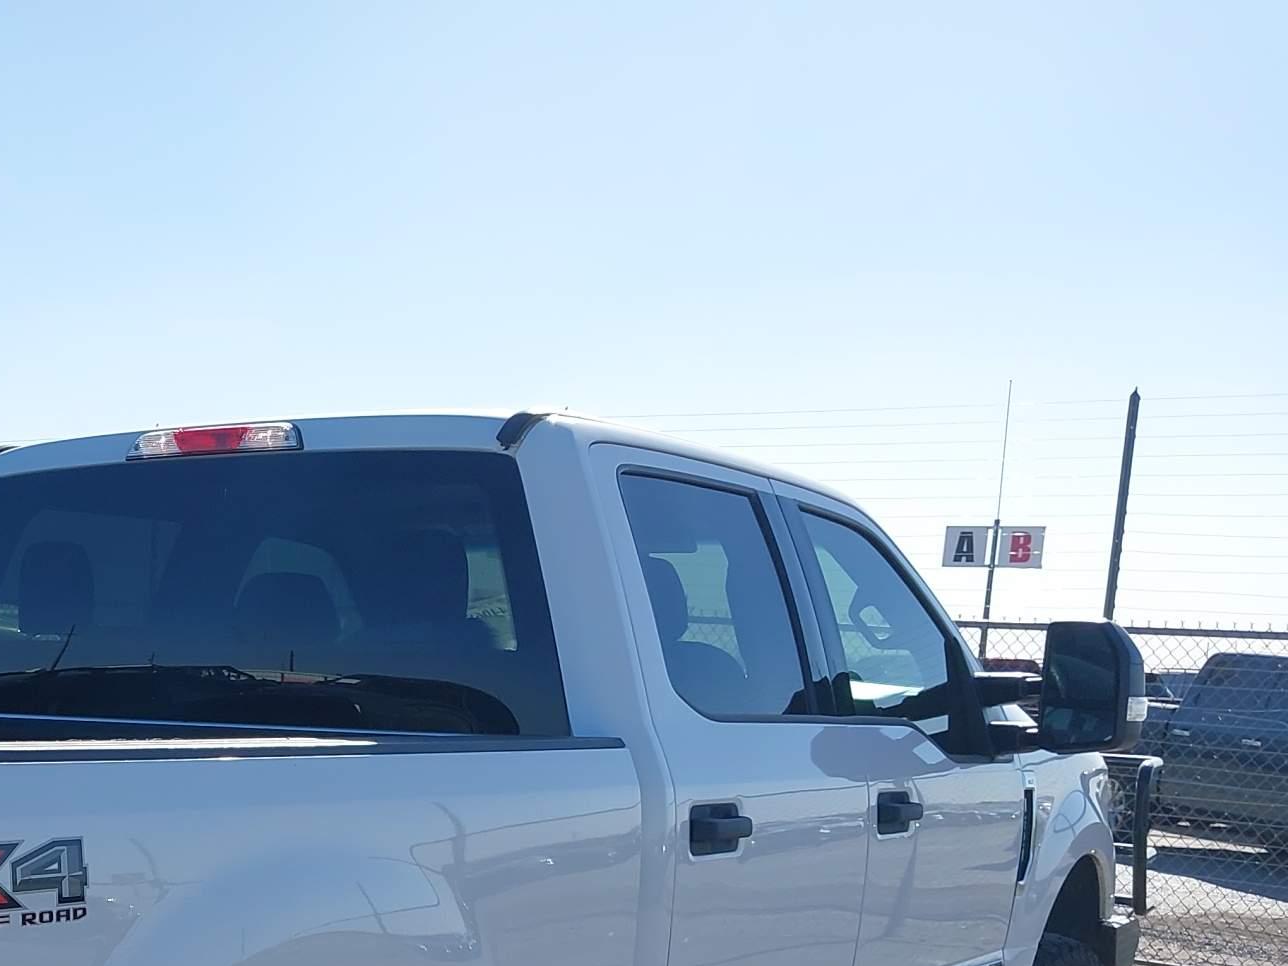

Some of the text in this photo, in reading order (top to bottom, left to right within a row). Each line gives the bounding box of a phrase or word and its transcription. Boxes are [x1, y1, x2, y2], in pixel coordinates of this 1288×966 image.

[953, 531, 1032, 563] A B
[21, 906, 88, 926] ROAD
